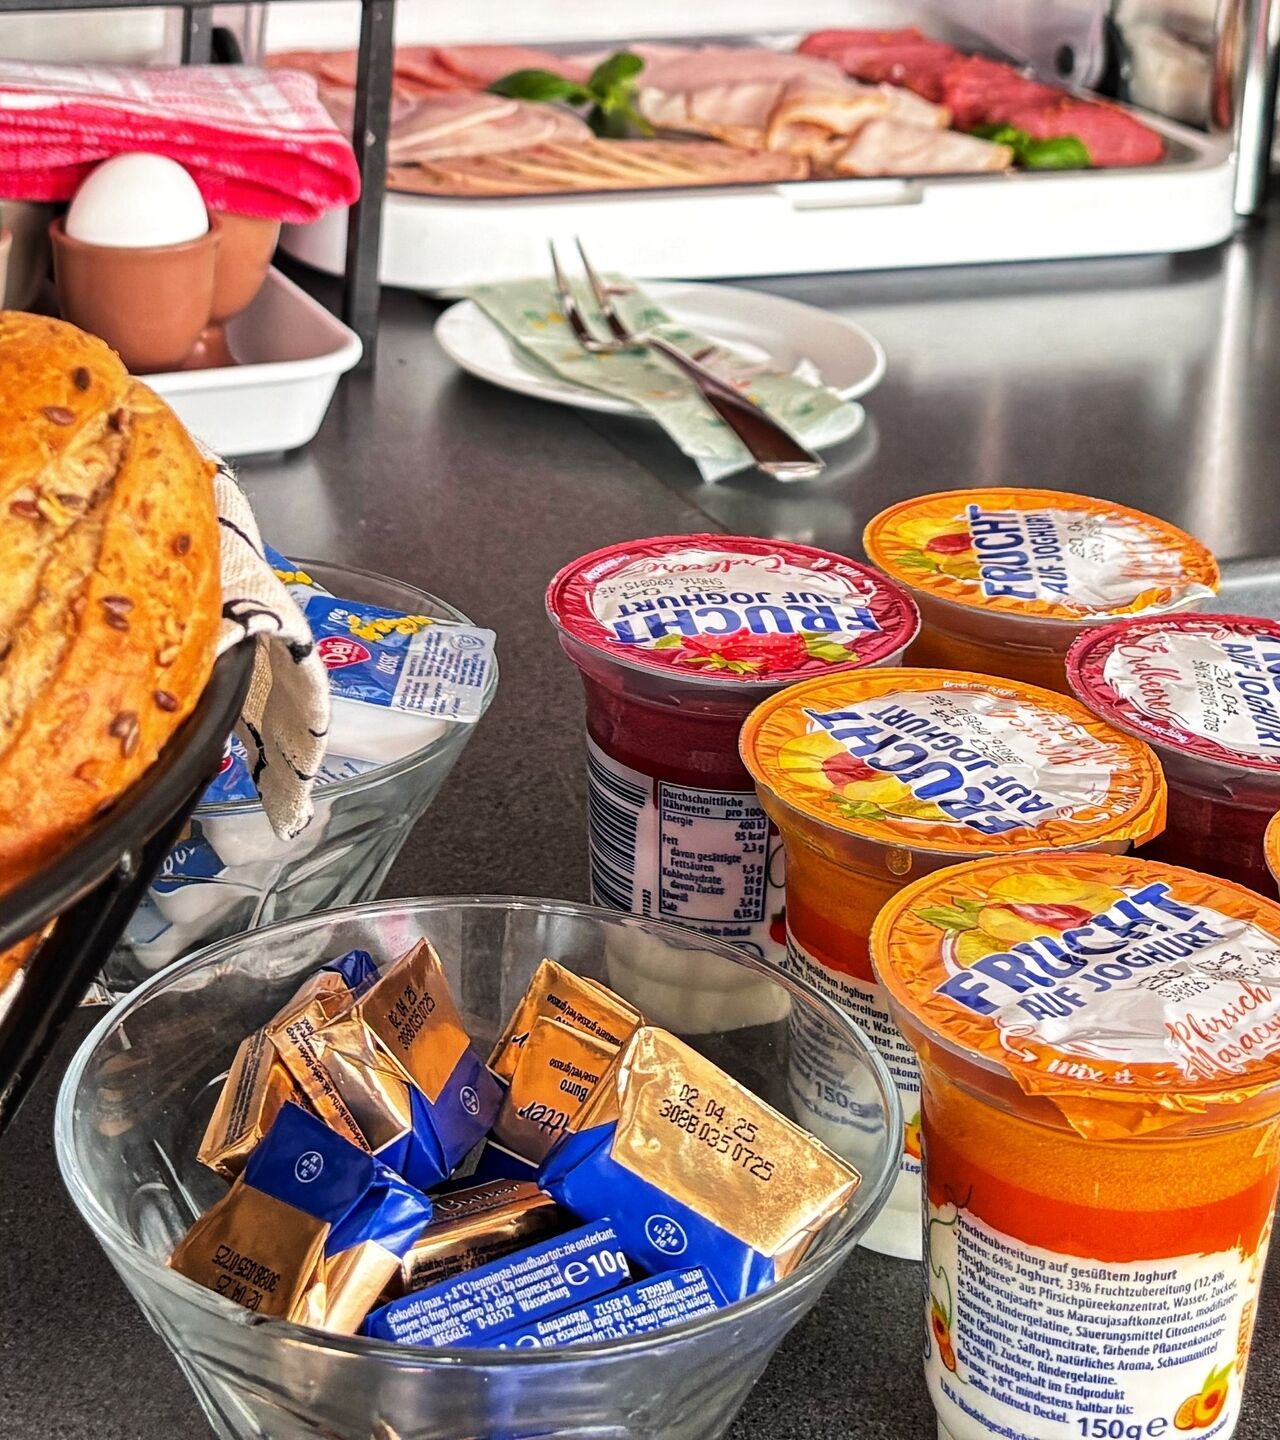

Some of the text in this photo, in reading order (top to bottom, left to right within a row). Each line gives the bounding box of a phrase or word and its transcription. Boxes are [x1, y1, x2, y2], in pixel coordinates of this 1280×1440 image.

[635, 554, 786, 575] Erdbeere
[967, 505, 1037, 599] FRUCHT
[1024, 513, 1070, 596] AUF JOGHURT
[618, 591, 841, 617] AUF JOGHURT
[608, 607, 882, 644] FRUCHT
[1221, 643, 1263, 673] AUF
[1119, 643, 1182, 715] Erdbeere
[867, 704, 999, 779] JOGHURT
[804, 708, 1030, 835] FRUCHT
[663, 788, 743, 807] Durchschnittliche
[663, 799, 741, 819] Nährwerte pro
[982, 775, 1054, 815] AUF
[663, 812, 693, 827] Energie
[748, 832, 765, 841] kcal
[663, 834, 678, 845] Fett
[671, 847, 742, 865] davon gesättigte
[663, 868, 722, 886] Kohlenhydrate
[671, 857, 714, 872] Fettsäuren
[662, 901, 678, 912] Salz
[696, 882, 725, 895] Zucker
[936, 882, 1200, 1015] FRUCHT
[1016, 986, 1087, 1023] AUF
[1081, 921, 1221, 995] JOGHURT
[840, 981, 874, 1003] Joghurt
[1167, 980, 1272, 1048] Pfirsich
[1048, 1058, 1109, 1082] mix
[560, 1079, 588, 1103] Burro
[518, 1101, 570, 1136] tter
[588, 1250, 630, 1278] 10g
[957, 1215, 1178, 1284] Fruchtzubereitung auf gesüßtem Joghurt
[957, 1231, 1225, 1297] Zutaten: 64% Joghurt, 33% Fruchtzubereitung (12,4%
[387, 1303, 421, 1324] Gekoeld
[470, 1269, 512, 1292] tenminste
[511, 1252, 550, 1276] houdbaar
[391, 1264, 559, 1336] Tenere frigo consumarsi
[462, 1274, 564, 1322] entro data impressa sul
[957, 1261, 977, 1281] 3,1%
[1046, 1306, 1065, 1319] aus
[1067, 1310, 1193, 1328] Maracujasaftkonzentrat,
[1018, 1282, 1208, 1313] aus Pfirsichpüreekonzentrat, Wasser,
[477, 1286, 570, 1330] D-83512 Wasserburg
[537, 1294, 631, 1334] D-83512 Wasserburg
[957, 1291, 1225, 1356] Säureregulator Natriumcitrate, färbende Pflanzenkonzen-
[966, 1281, 994, 1308] Stärke,
[997, 1300, 1073, 1336] Rindergelatine,
[1076, 1326, 1163, 1344] Säuerungsmittel
[557, 1313, 613, 1342] data impressa
[977, 1317, 1218, 1371] (Karotte, Saflor), natürliches Aroma, Schaummittel
[987, 1355, 1125, 1400] Fruchtgehalt im Endprodukt
[1001, 1347, 1034, 1371] Zucker,
[1037, 1361, 1118, 1386] Rindergelatine.
[990, 1388, 1070, 1424] Aufdruck Deckel.
[1016, 1382, 1113, 1414] mindestens haltbar
[1078, 1417, 1143, 1440] 150g
